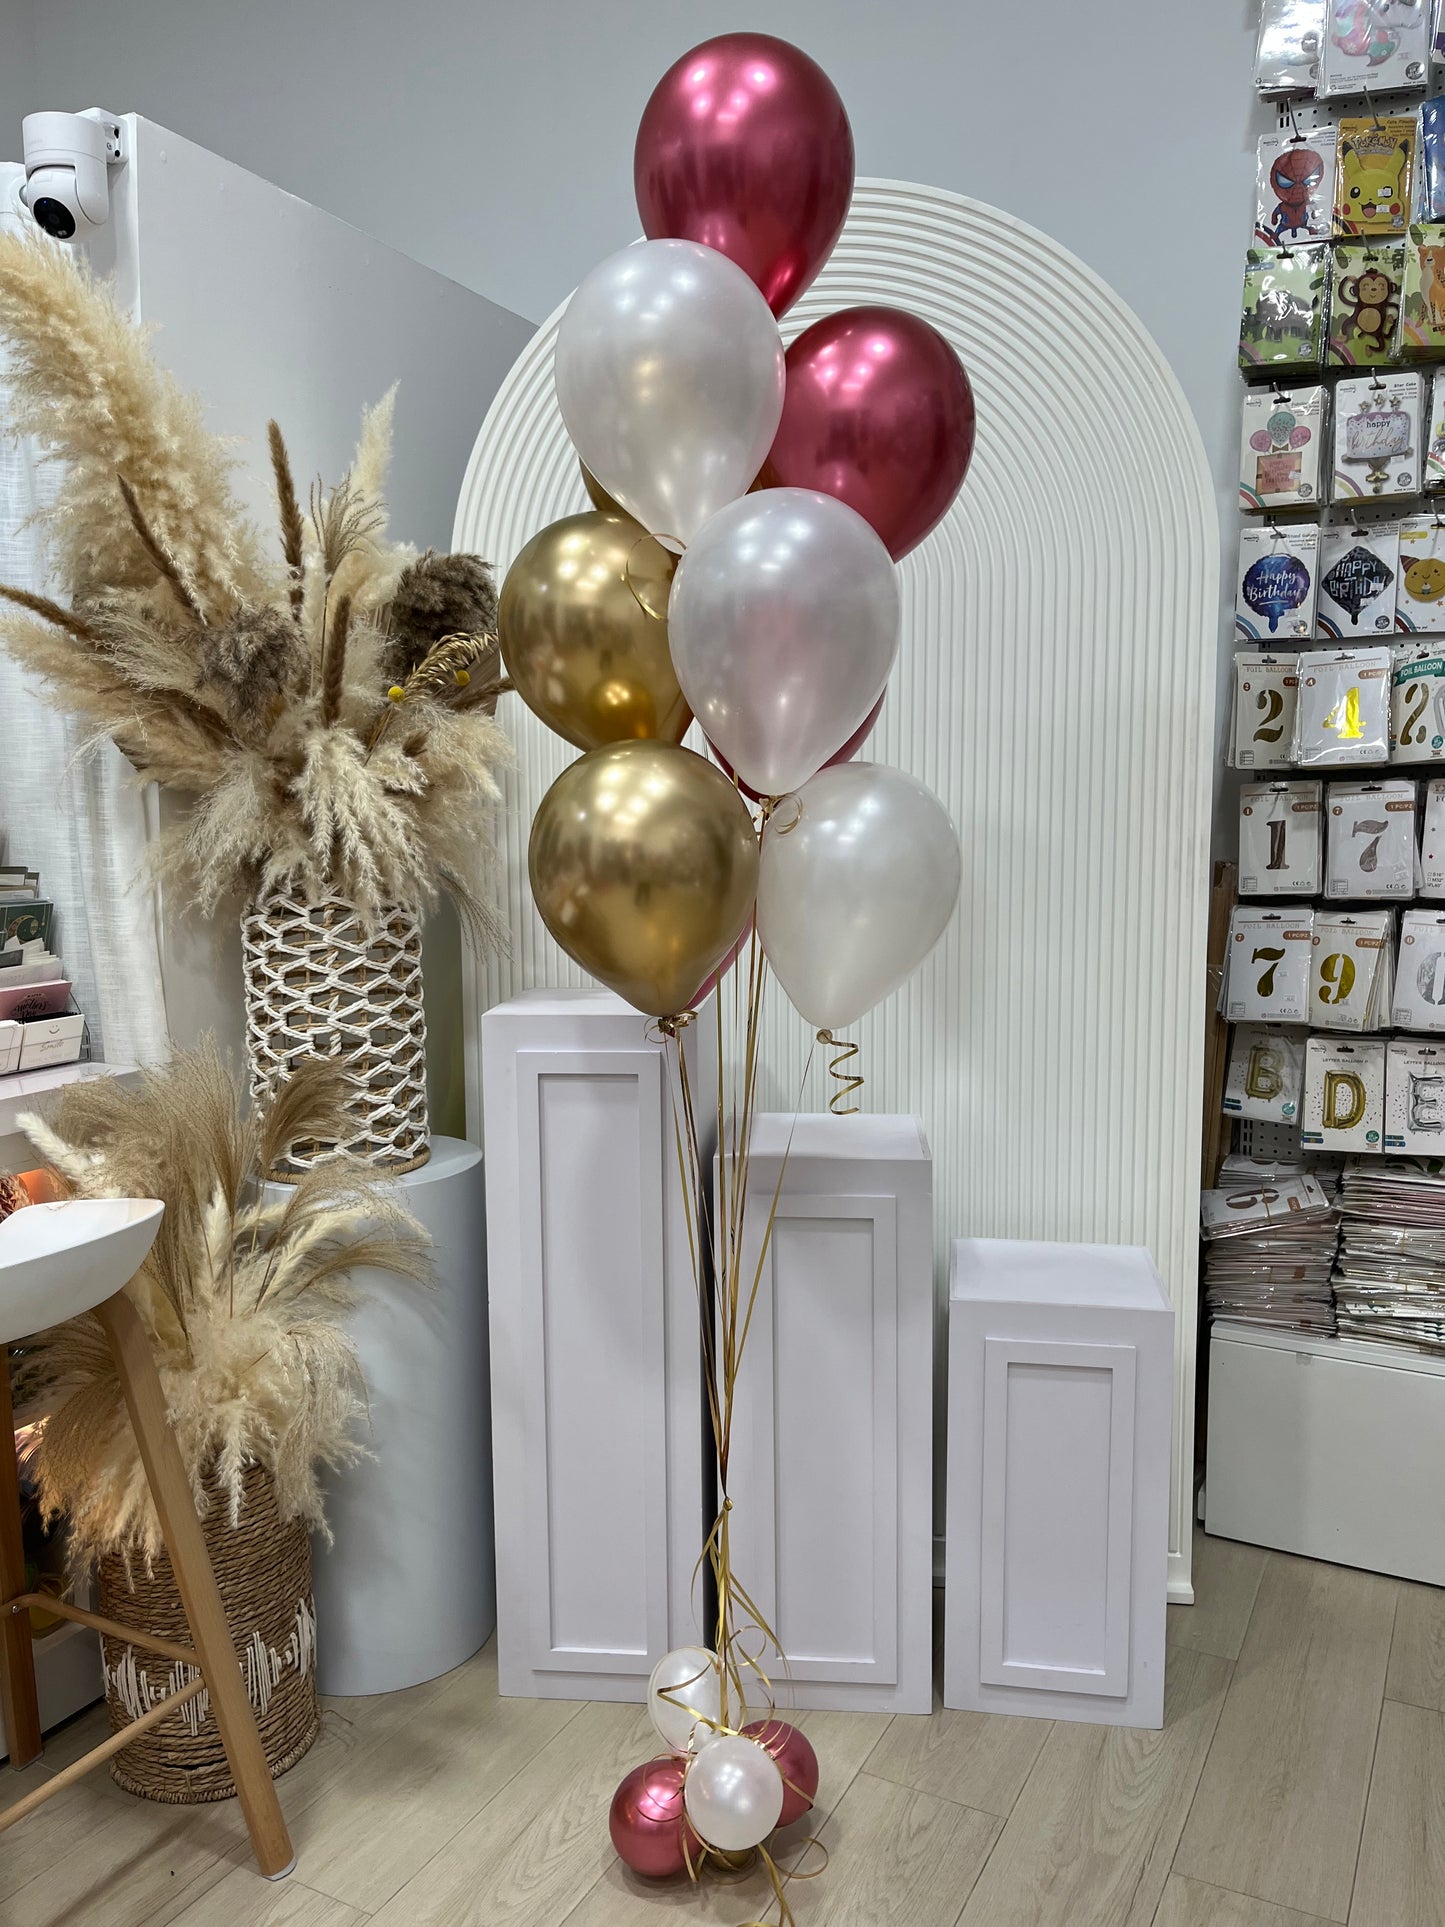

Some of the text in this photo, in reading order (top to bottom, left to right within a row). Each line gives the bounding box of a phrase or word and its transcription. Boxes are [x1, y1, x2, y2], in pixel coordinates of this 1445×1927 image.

[1351, 427, 1404, 453] birthday
[1366, 420, 1391, 428] happy
[1249, 585, 1301, 601] Birthday
[1256, 570, 1297, 585] Happy
[1335, 560, 1377, 578] HAPPY
[1400, 661, 1442, 677] FOIL BALLOON
[1253, 689, 1284, 743] 2
[1322, 687, 1367, 740] 4
[1265, 819, 1290, 870] 1
[1351, 819, 1389, 873] 7
[1341, 928, 1374, 936] BALLOON
[1251, 947, 1286, 998] 7
[1318, 953, 1356, 1005] 9
[1245, 1046, 1284, 1101] B
[1322, 1069, 1368, 1130] D
[1407, 1071, 1445, 1134] E
